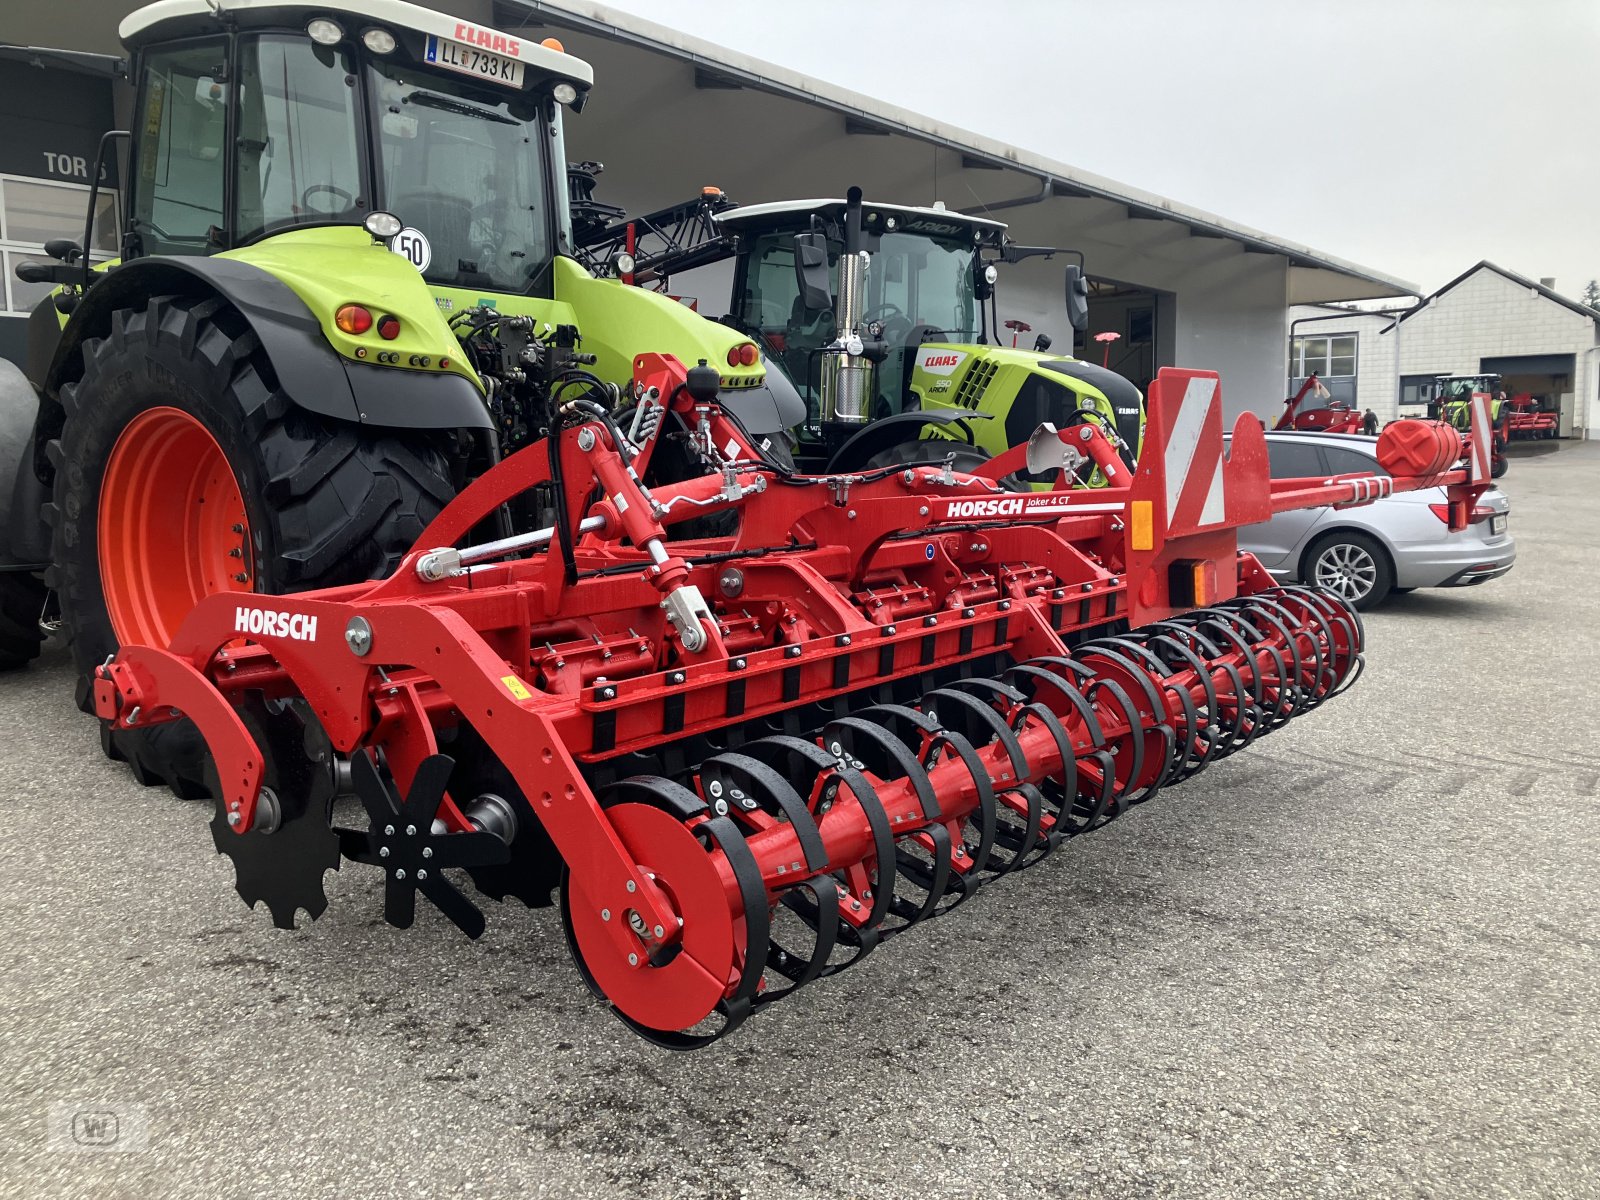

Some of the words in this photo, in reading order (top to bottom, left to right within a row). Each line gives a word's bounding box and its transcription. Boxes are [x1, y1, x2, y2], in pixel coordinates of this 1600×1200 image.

[454, 23, 520, 57] CLAAS
[442, 43, 458, 65] LL
[43, 151, 88, 178] TOR
[906, 220, 963, 234] ARION
[400, 235, 423, 266] 50
[924, 355, 959, 368] CLAAS
[936, 379, 952, 387] 550
[1118, 407, 1139, 415] CLAAS
[947, 498, 1024, 518] HORSCH
[1026, 497, 1050, 507] Joker
[1050, 496, 1057, 505] 4
[1058, 496, 1071, 505] CT
[235, 606, 318, 642] HORSCH
